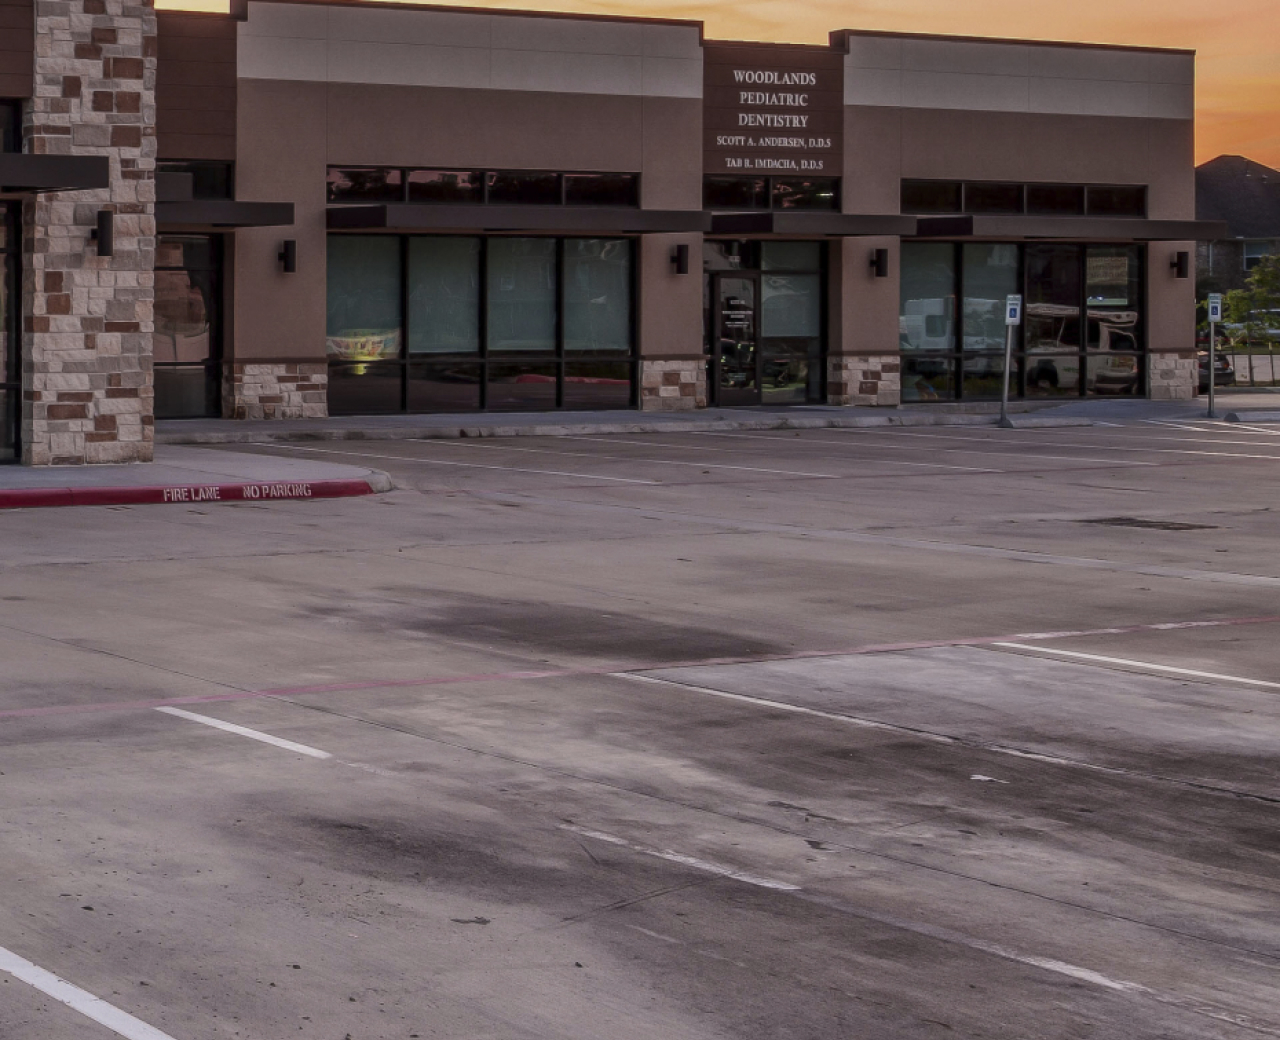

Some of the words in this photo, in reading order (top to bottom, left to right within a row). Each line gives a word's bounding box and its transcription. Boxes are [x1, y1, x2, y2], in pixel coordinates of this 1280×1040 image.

[733, 69, 817, 86] WOODLANDS
[739, 91, 809, 107] PEDIATRIC
[738, 113, 809, 128] DENTISTRY
[716, 135, 746, 146] SCOTT
[747, 137, 757, 147] A.
[758, 137, 808, 150] ANDERSEN,
[809, 138, 831, 148] D.D.S
[801, 160, 824, 169] D.D.S
[163, 488, 188, 502] FIRE
[191, 486, 221, 501] LANE
[243, 485, 260, 499] NO
[262, 483, 312, 498] PARKING
